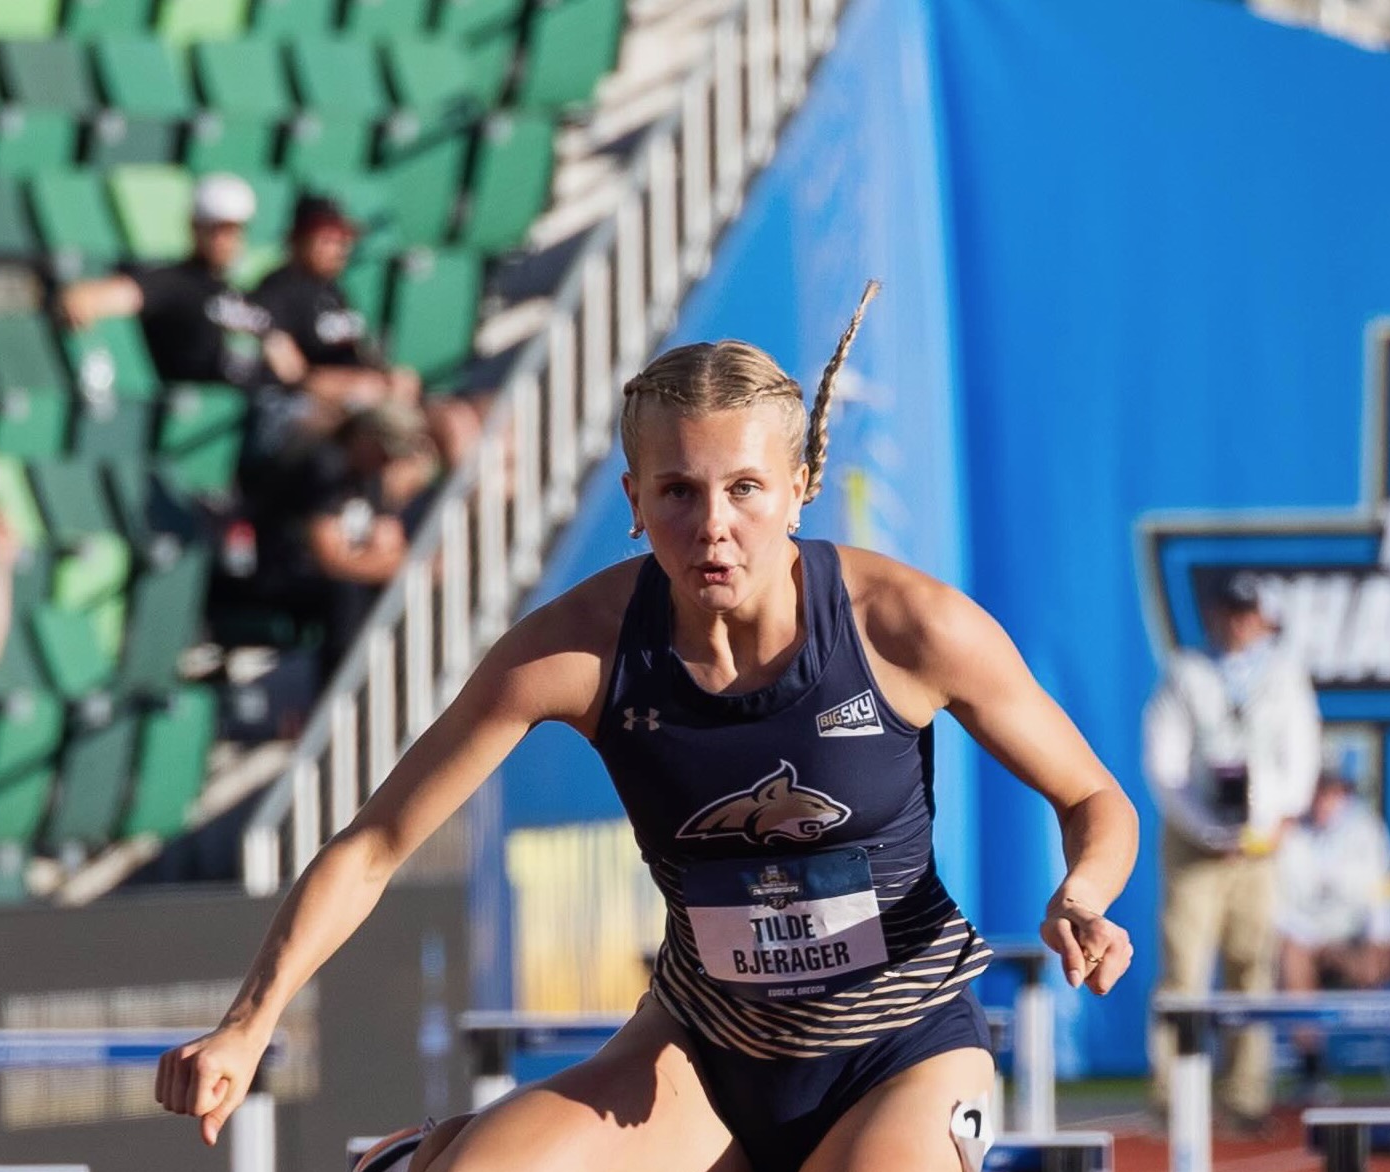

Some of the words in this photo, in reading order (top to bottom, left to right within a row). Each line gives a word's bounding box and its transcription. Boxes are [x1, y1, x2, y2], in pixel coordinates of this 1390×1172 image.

[820, 710, 842, 727] BIG
[841, 696, 875, 723] SKY
[750, 914, 816, 943] TILDE
[733, 941, 850, 974] BJERAGER
